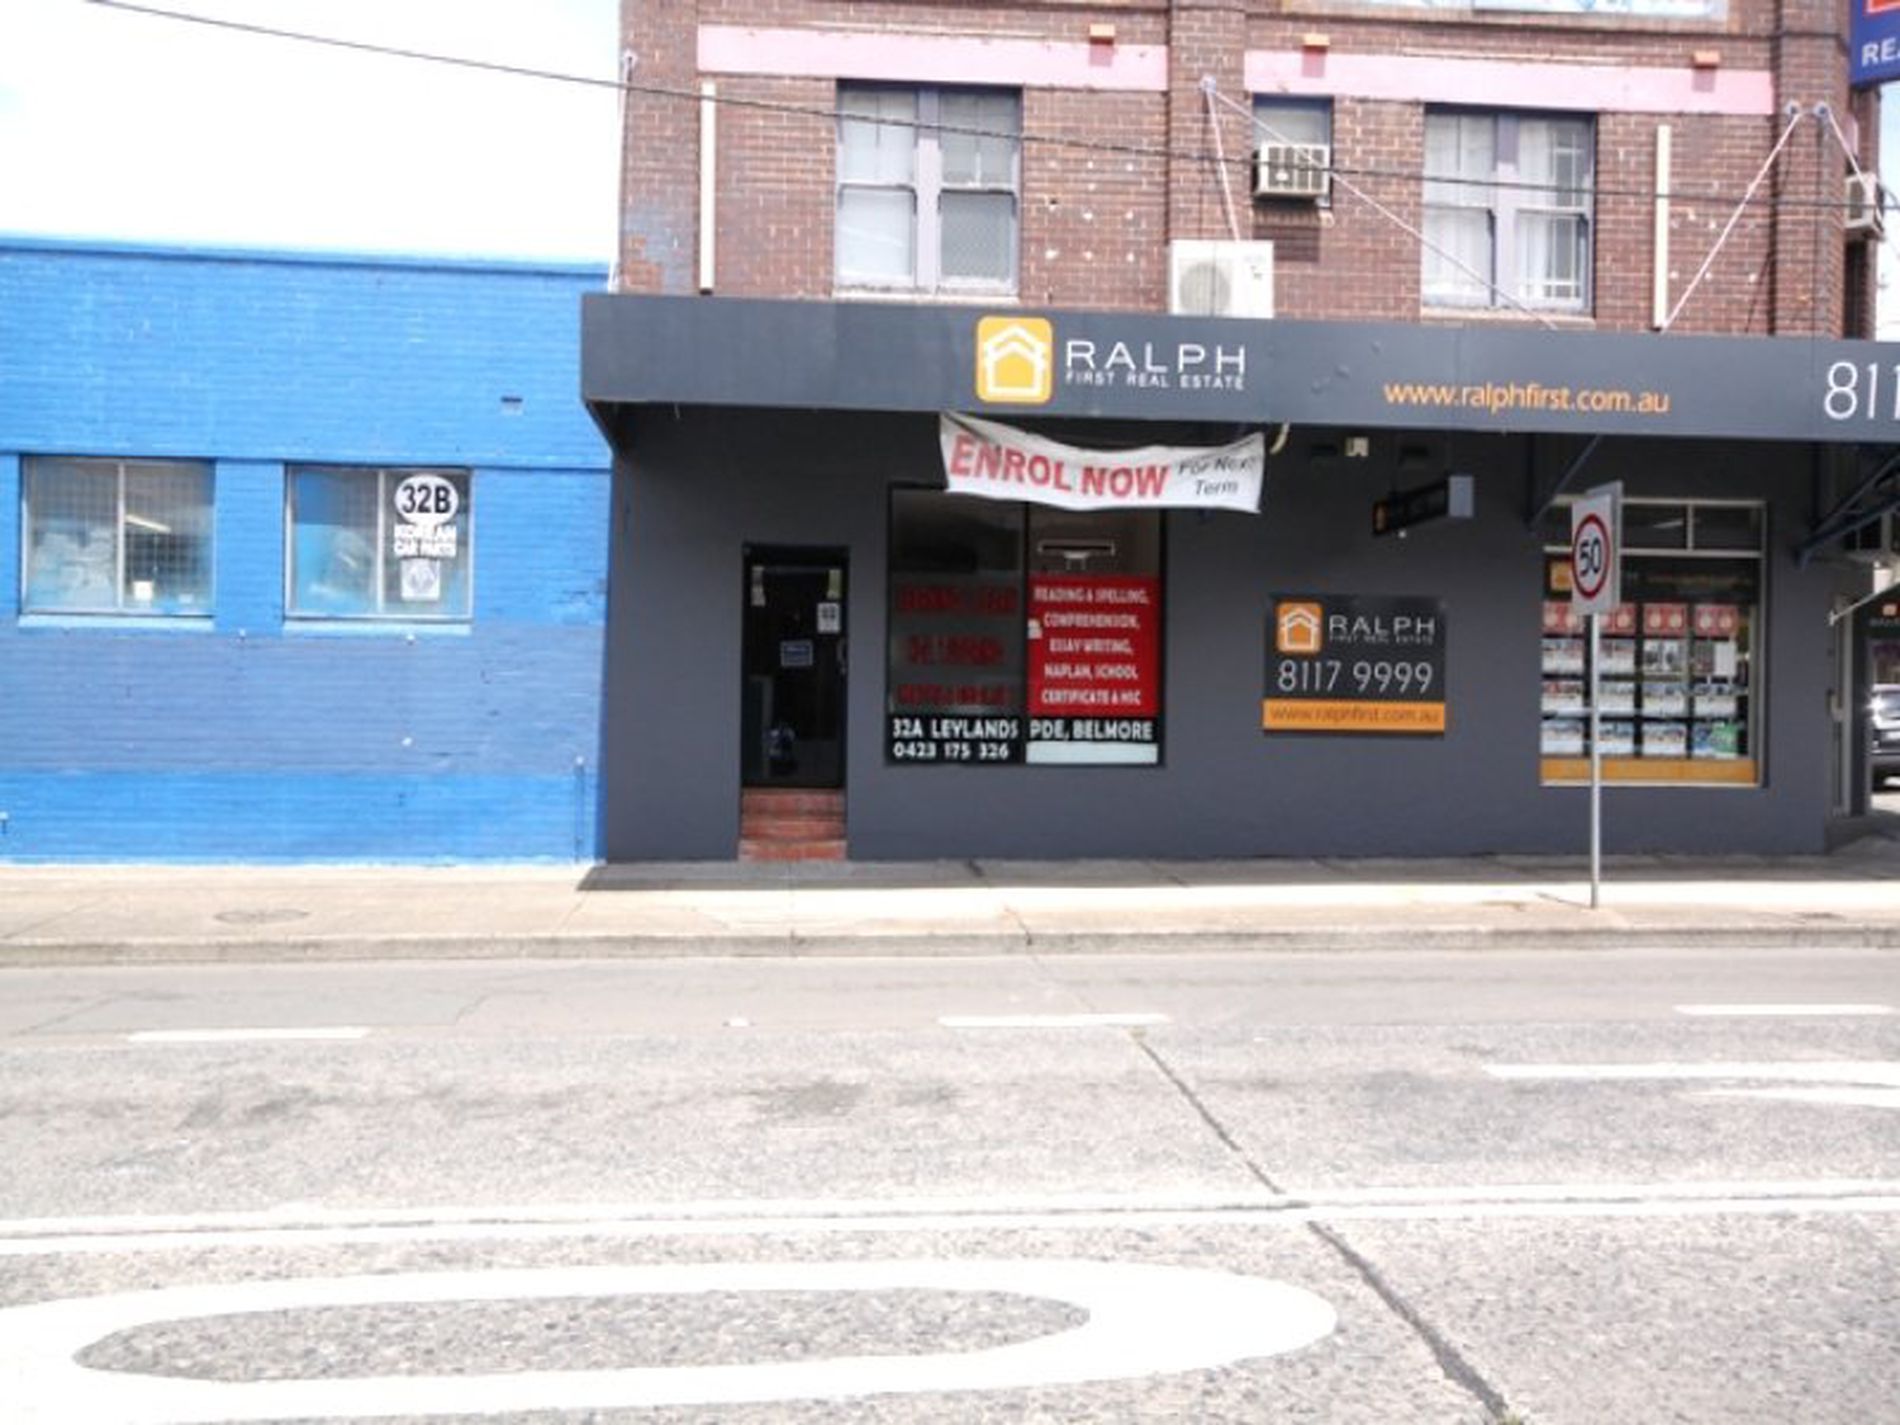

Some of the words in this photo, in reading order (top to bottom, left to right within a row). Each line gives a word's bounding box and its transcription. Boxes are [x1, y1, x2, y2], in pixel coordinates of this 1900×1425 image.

[1862, 36, 1900, 67] RE
[1065, 339, 1246, 374] RALPH
[1065, 371, 1115, 386] FIRST
[1127, 372, 1169, 388] REAL
[1180, 374, 1245, 390] ESTATE
[1384, 381, 1671, 415] www.ralphfirst.com.au
[949, 433, 1072, 493] ENROL
[1080, 464, 1171, 497] NOW
[402, 484, 451, 514] 32B
[1195, 478, 1238, 496] Term
[1579, 538, 1602, 577] 50
[1328, 614, 1436, 636] RALPH
[1277, 659, 1342, 692] 8117
[1353, 660, 1433, 694] 9999
[893, 718, 923, 738] 32A
[931, 718, 1019, 739] LEYLANDS
[1073, 720, 1153, 740] BELMORE
[893, 741, 937, 759] 0423
[944, 741, 970, 759] 175
[979, 741, 1009, 760] 326
